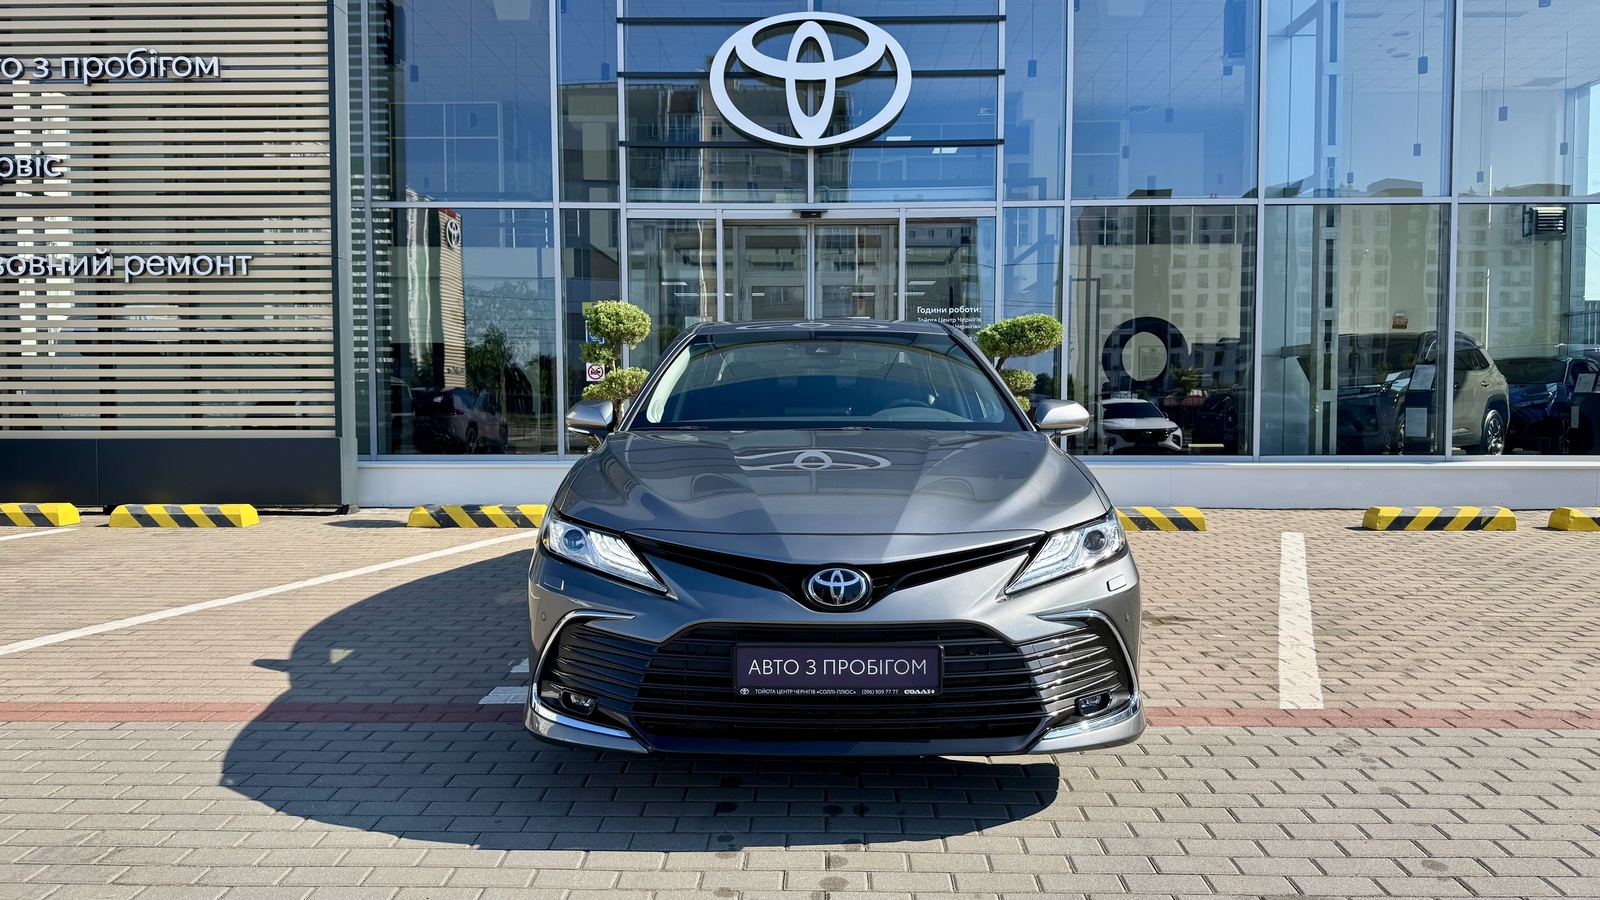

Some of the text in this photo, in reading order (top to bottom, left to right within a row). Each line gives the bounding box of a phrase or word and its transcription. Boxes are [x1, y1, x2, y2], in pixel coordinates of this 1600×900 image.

[32, 57, 50, 79] з
[61, 47, 220, 85] пробігом
[124, 254, 253, 283] ремонт
[917, 306, 982, 315] Години роботи:
[748, 659, 927, 675] АВТО З ПРОБІГОМ
